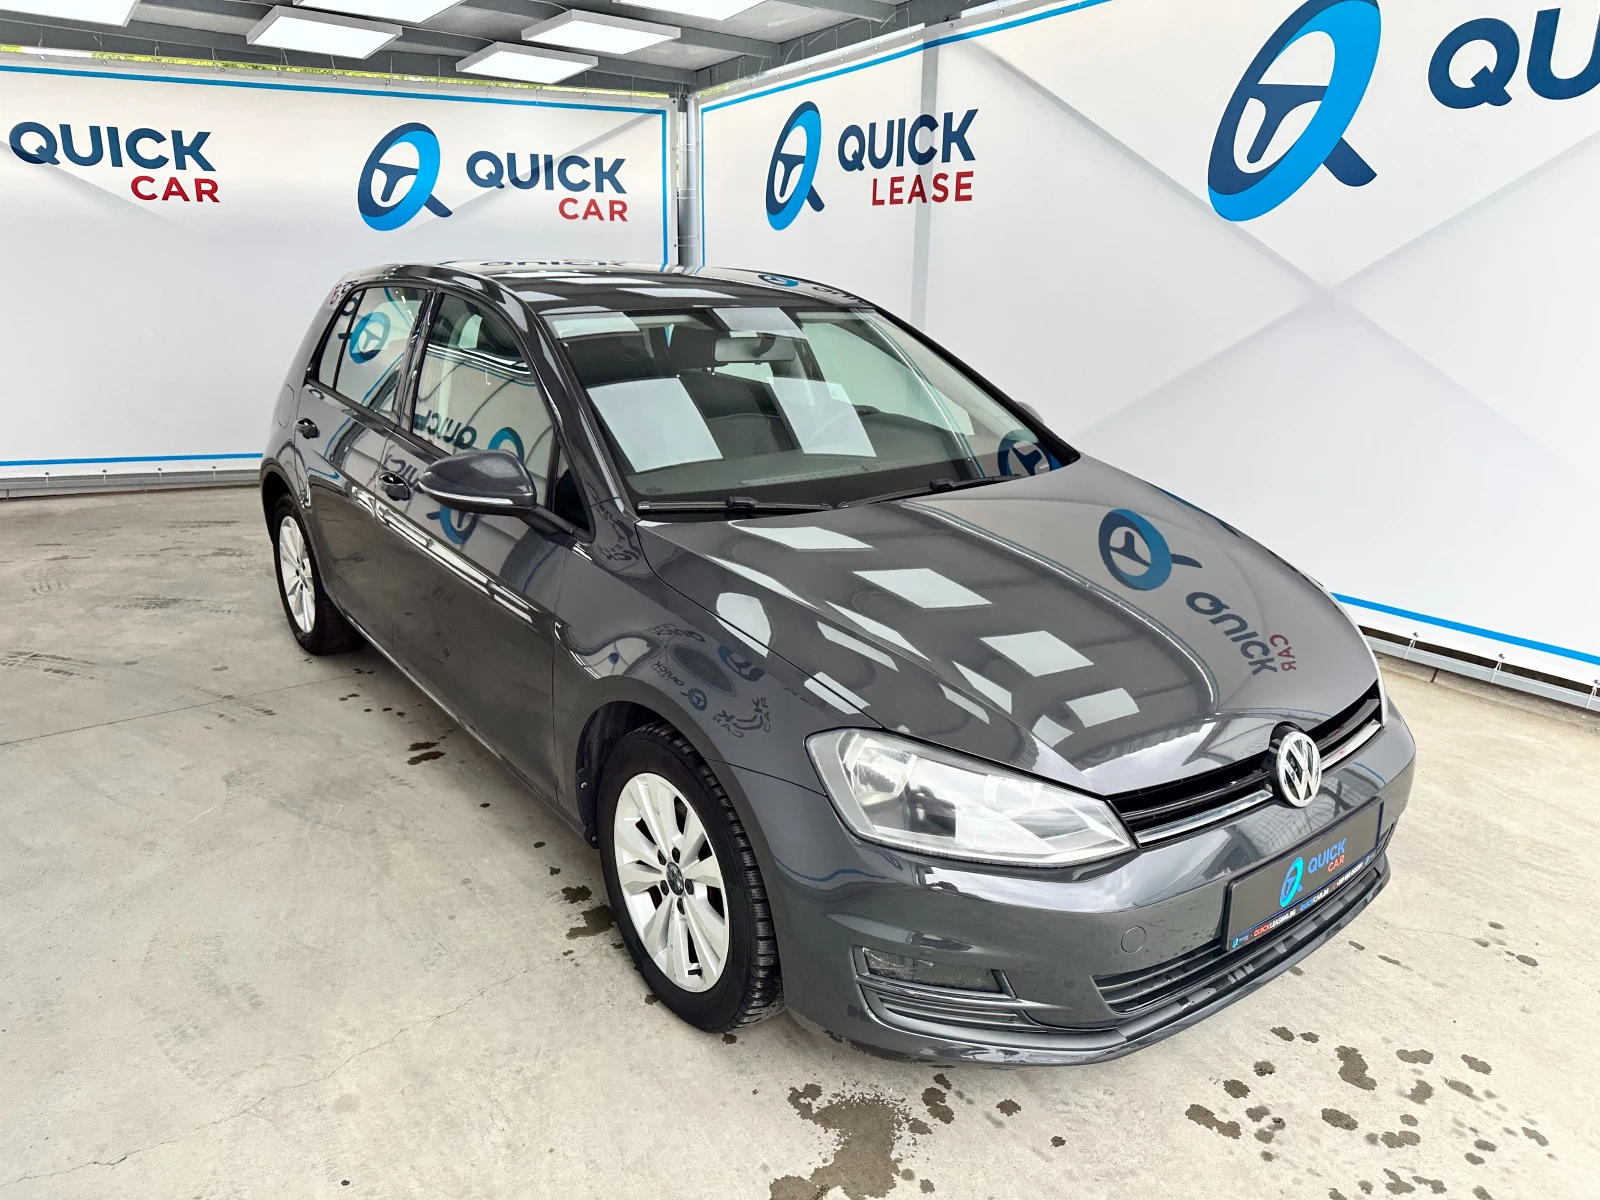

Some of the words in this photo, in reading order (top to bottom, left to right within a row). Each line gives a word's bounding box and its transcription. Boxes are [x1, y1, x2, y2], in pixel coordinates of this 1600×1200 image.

[9, 121, 217, 172] QUICK
[838, 108, 979, 172] QUICK
[131, 175, 220, 203] CAR
[466, 150, 628, 194] QUICK
[872, 171, 974, 206] LEASE
[558, 197, 628, 222] CAR
[1308, 837, 1347, 874] QUICK
[1328, 854, 1345, 873] CAR
